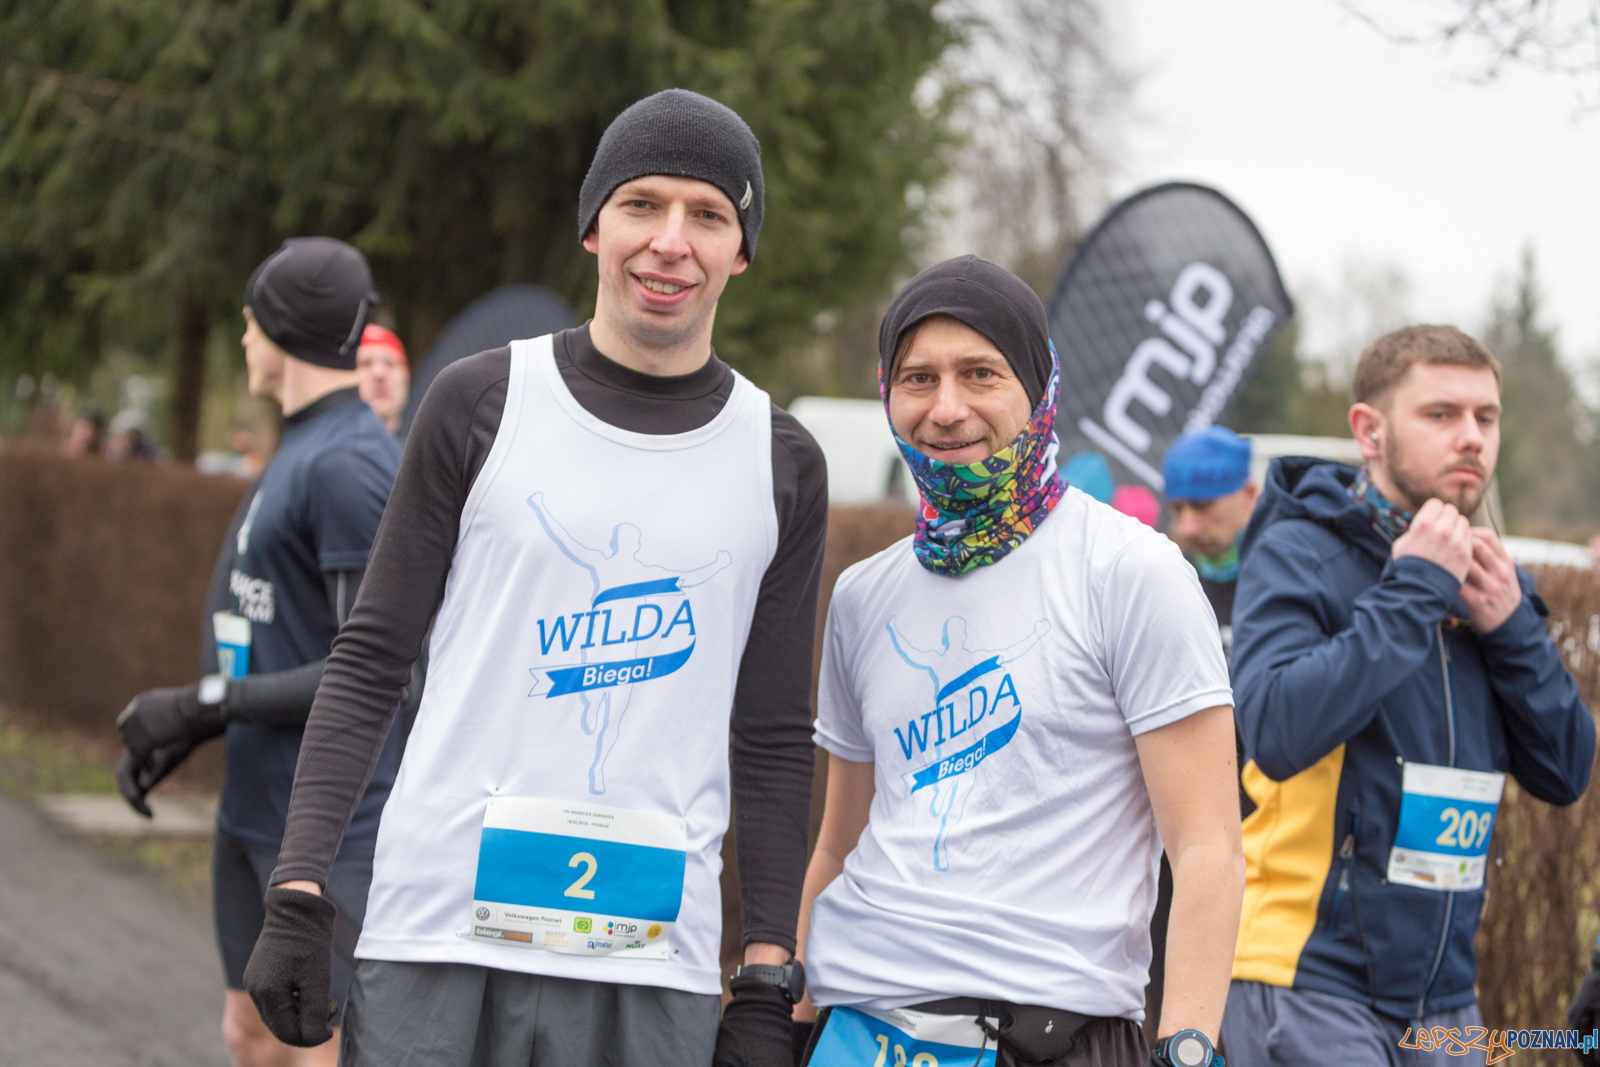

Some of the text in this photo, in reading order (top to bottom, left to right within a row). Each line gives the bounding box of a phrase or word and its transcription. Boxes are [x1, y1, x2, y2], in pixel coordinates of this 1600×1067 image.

[1103, 261, 1234, 453] mjp
[536, 599, 696, 656] WILDA
[582, 658, 653, 687] Biega!
[893, 673, 1021, 761] WILDA
[937, 736, 987, 780] Biega!
[1436, 807, 1492, 849] 209
[563, 851, 598, 900] 2
[504, 911, 540, 922] Volkswagen
[540, 915, 562, 924] Poznań
[616, 923, 638, 935] mjp
